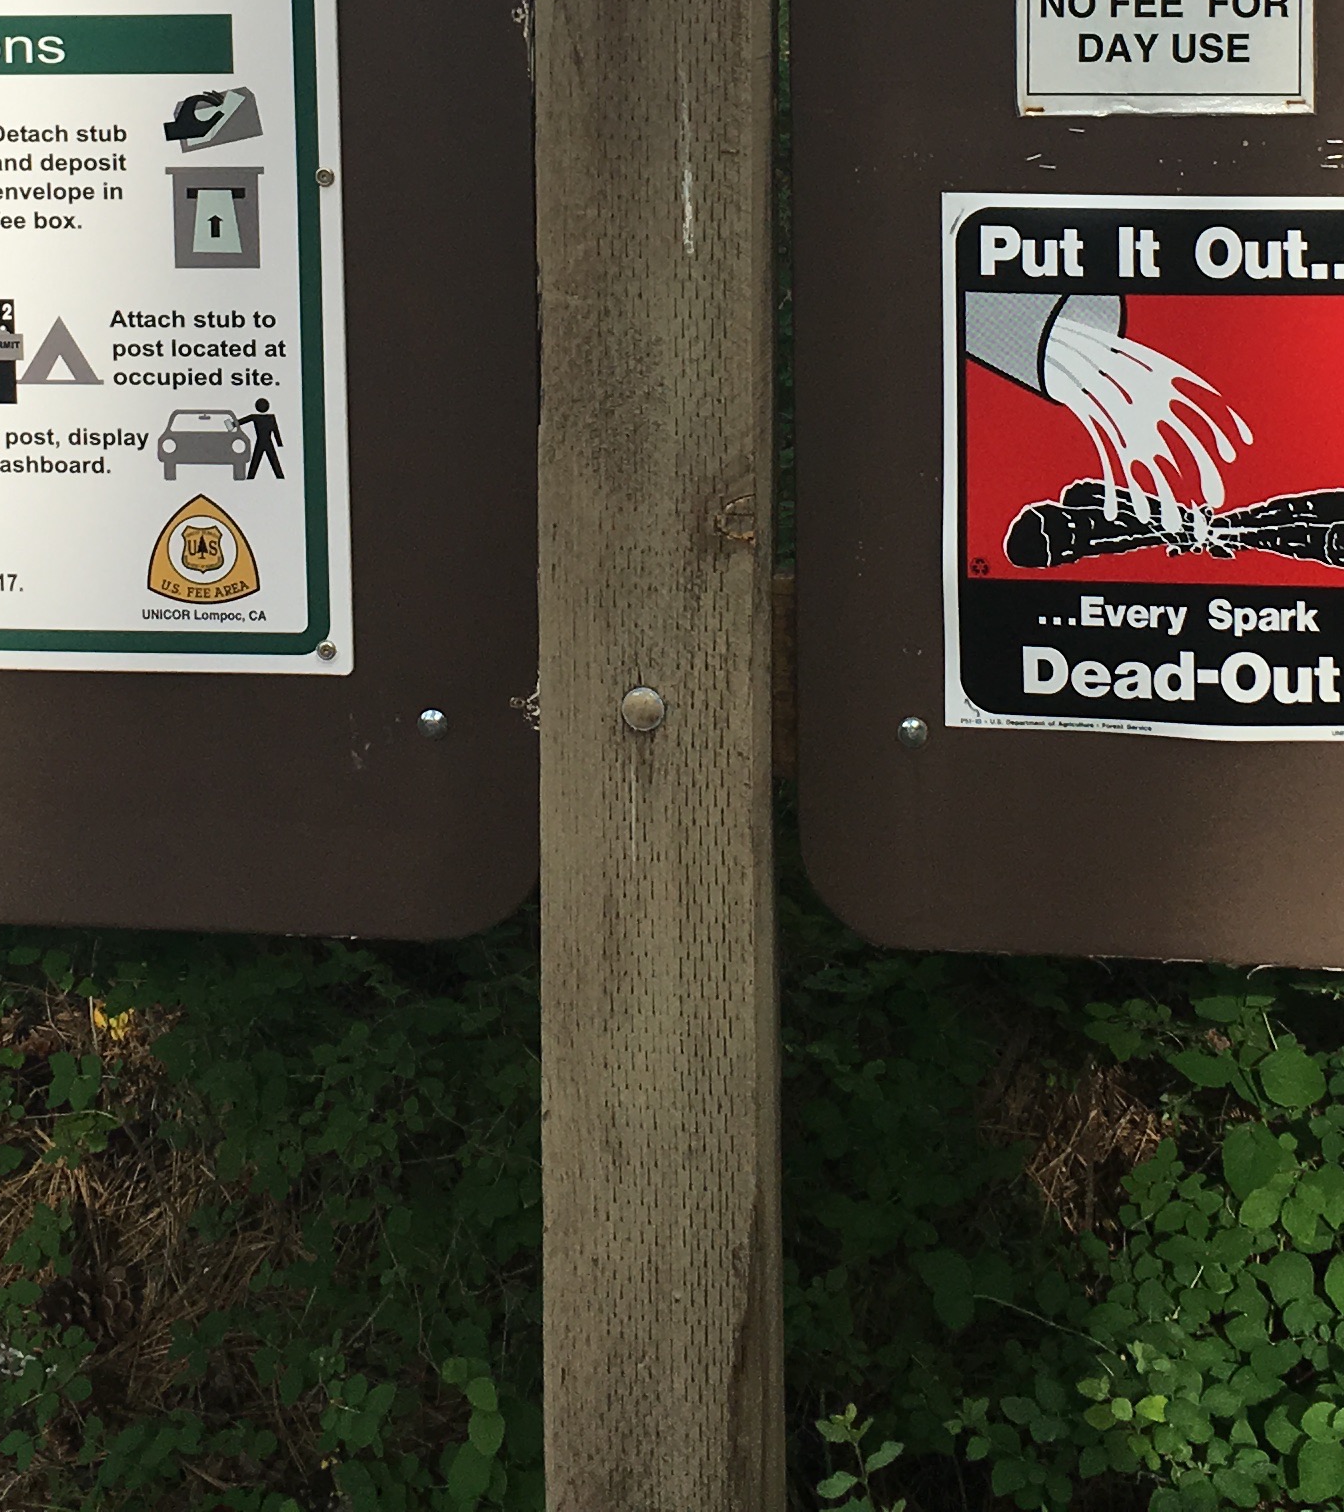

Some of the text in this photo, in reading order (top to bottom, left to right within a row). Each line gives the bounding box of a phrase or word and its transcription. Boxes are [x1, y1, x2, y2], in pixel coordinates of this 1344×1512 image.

[1078, 32, 1251, 64] DAY USE
[980, 224, 1084, 278] Put
[1118, 226, 1161, 278] It
[141, 608, 267, 624] UNICOR Lompoc, CA
[1038, 595, 1321, 638] ...Every Spark
[1022, 645, 1341, 705] Dead-Out
